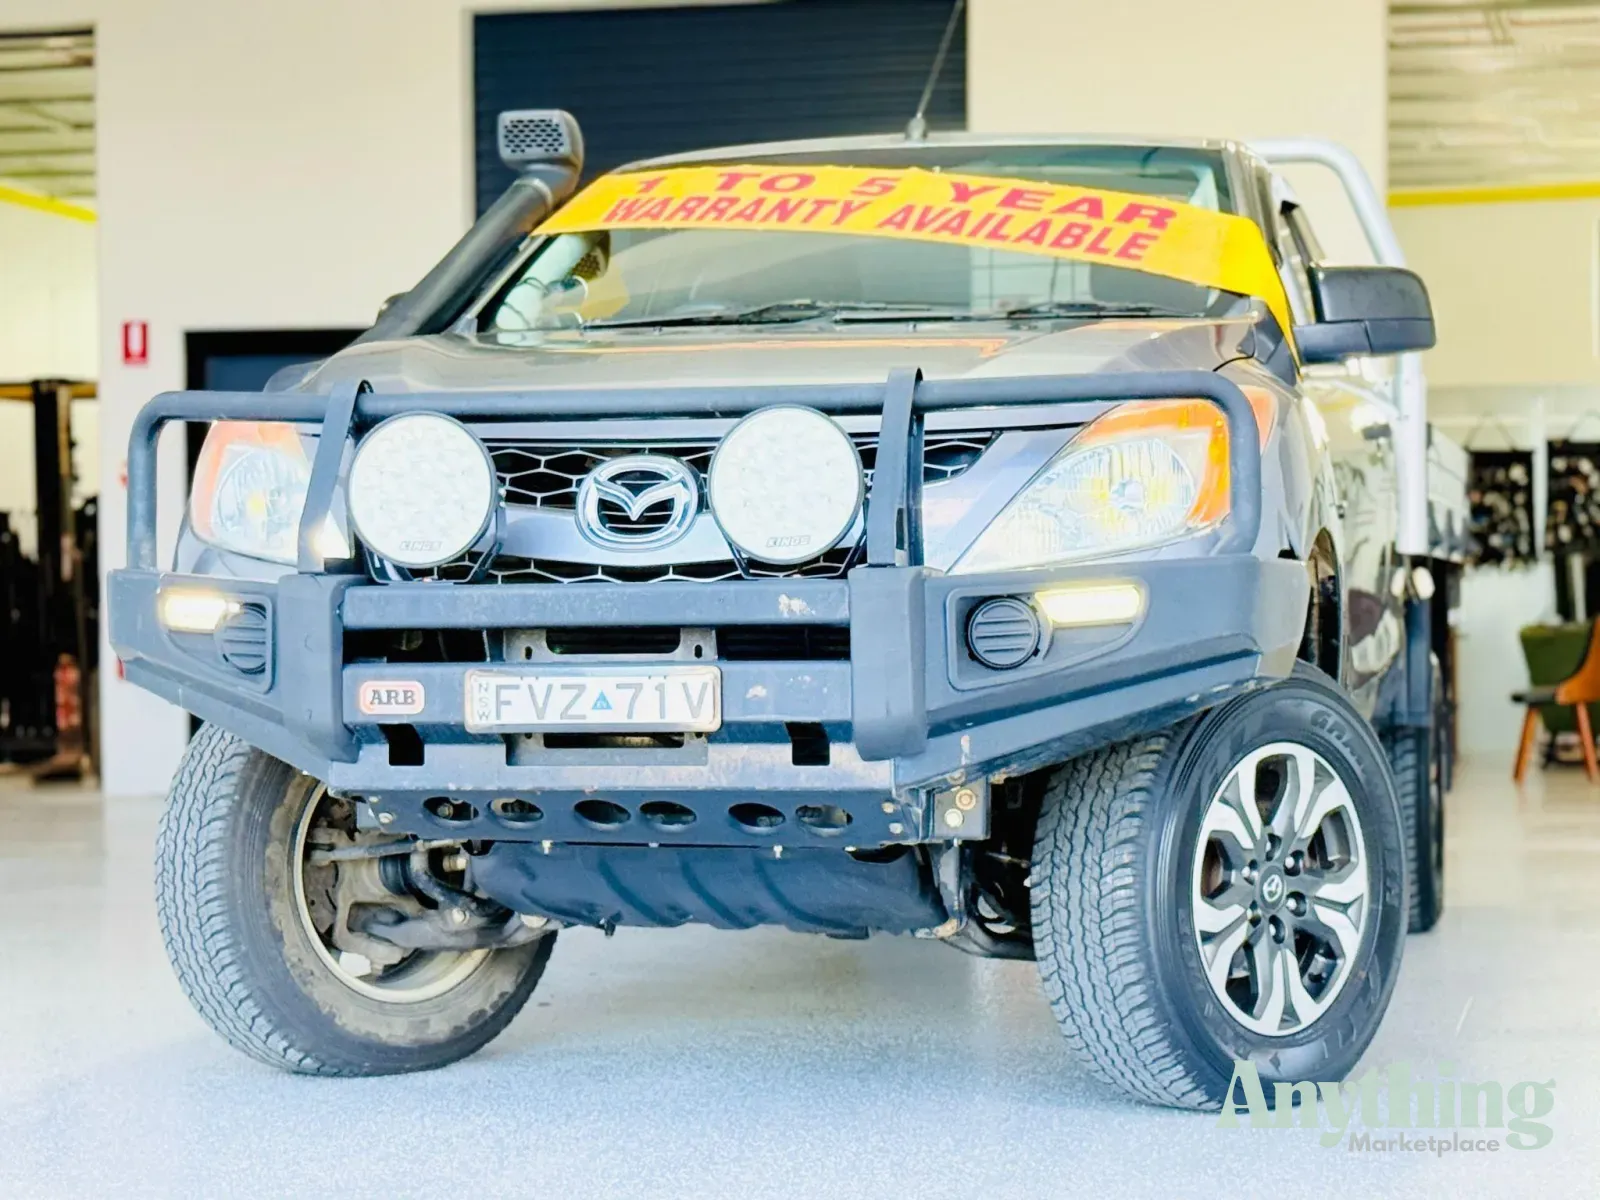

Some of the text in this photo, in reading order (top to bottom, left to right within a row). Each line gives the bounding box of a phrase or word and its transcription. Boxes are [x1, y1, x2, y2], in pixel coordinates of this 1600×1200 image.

[635, 172, 1177, 231] 1 TO 5 YEAR
[602, 195, 1160, 262] WARRANTY AVAILABLE
[369, 689, 417, 706] ARB
[494, 683, 588, 721] FVZ
